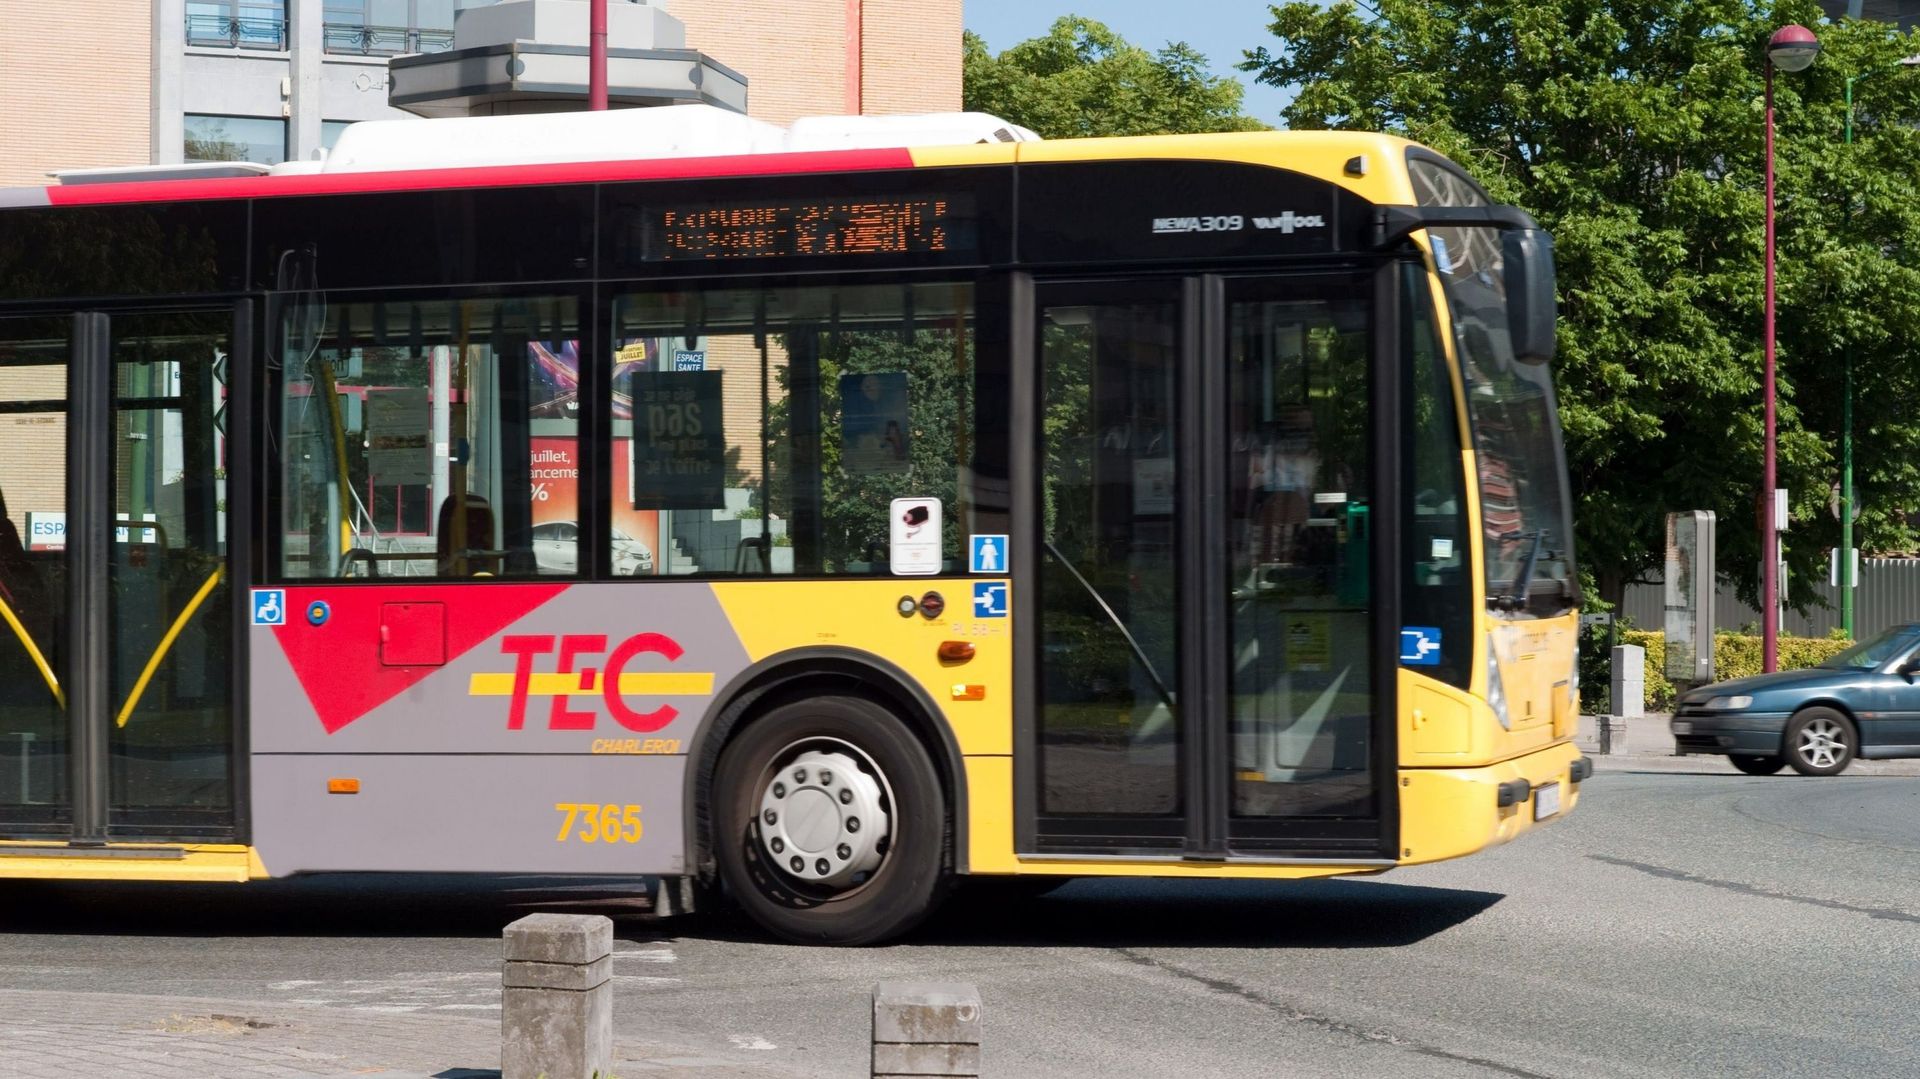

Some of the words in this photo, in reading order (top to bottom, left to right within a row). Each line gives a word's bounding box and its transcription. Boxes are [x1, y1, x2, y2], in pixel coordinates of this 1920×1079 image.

[676, 354, 703, 363] ESPACE
[647, 402, 702, 448] pas
[530, 450, 571, 466] juillet,
[501, 632, 685, 733] TEC
[592, 739, 681, 754] CHARLEROI
[555, 803, 642, 843] 7365
